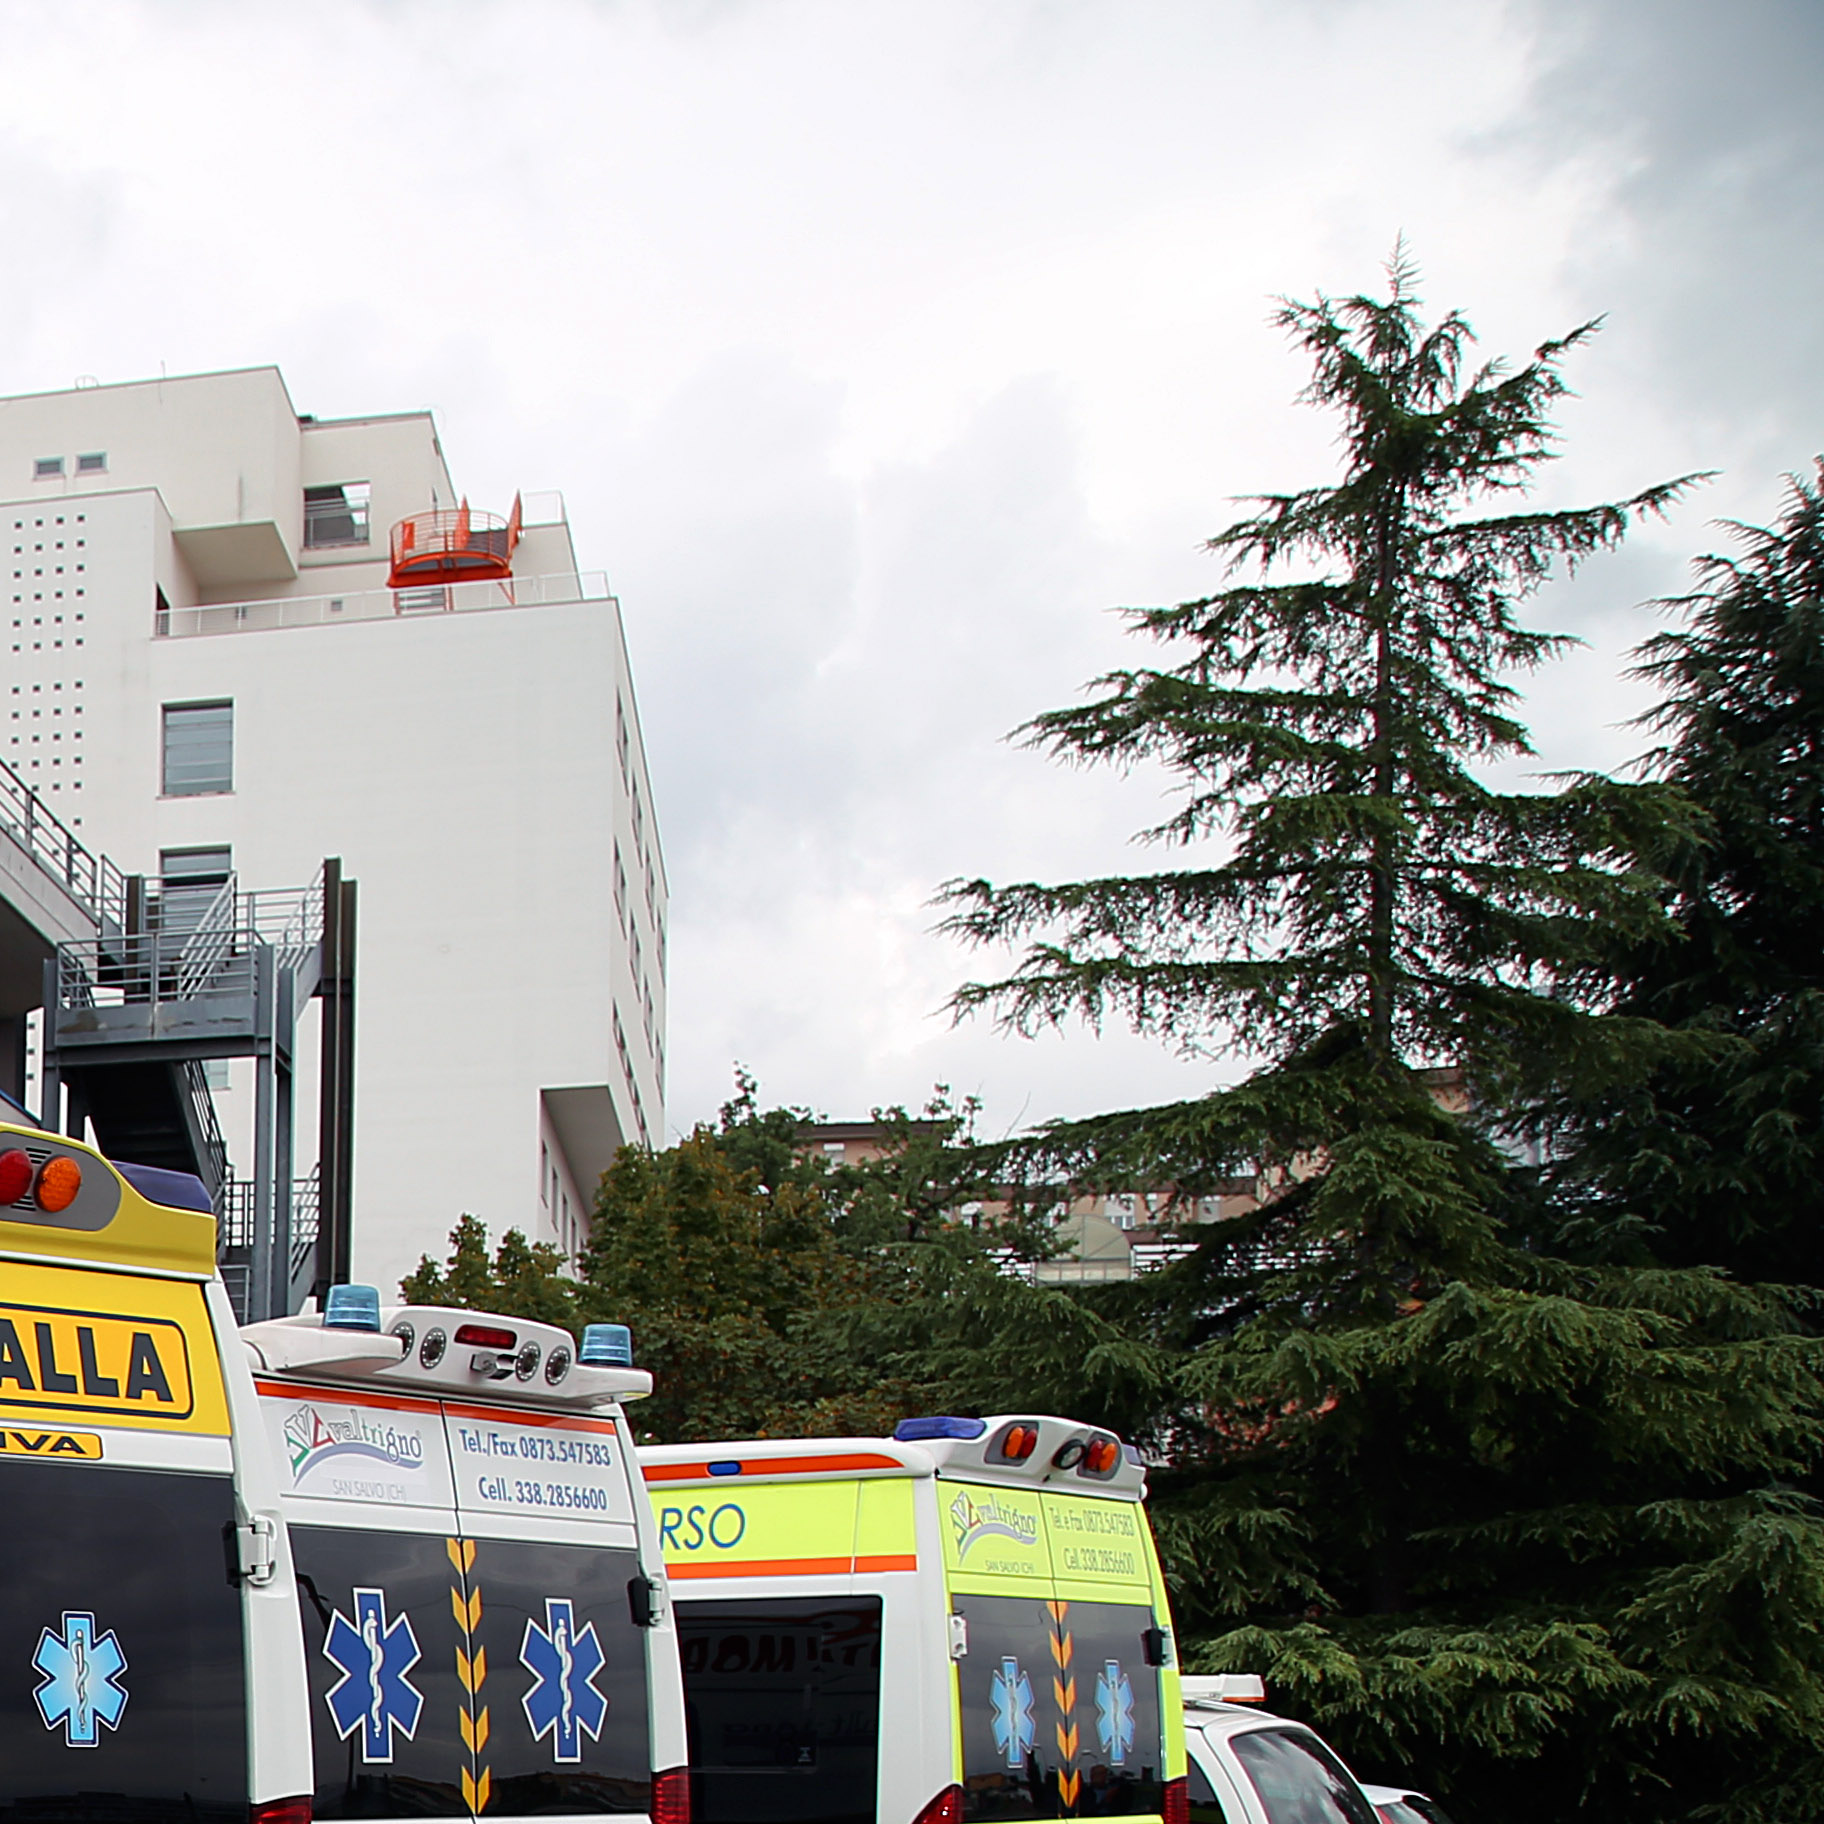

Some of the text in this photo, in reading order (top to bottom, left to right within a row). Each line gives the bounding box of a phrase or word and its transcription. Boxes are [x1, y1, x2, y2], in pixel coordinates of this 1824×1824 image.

[328, 1408, 422, 1463] valtrigno
[458, 1428, 611, 1466] Tel./Fax 0873.547583
[333, 1479, 352, 1495] SAN
[354, 1480, 385, 1499] SALVO
[478, 1476, 608, 1510] Cell. 338.2856600
